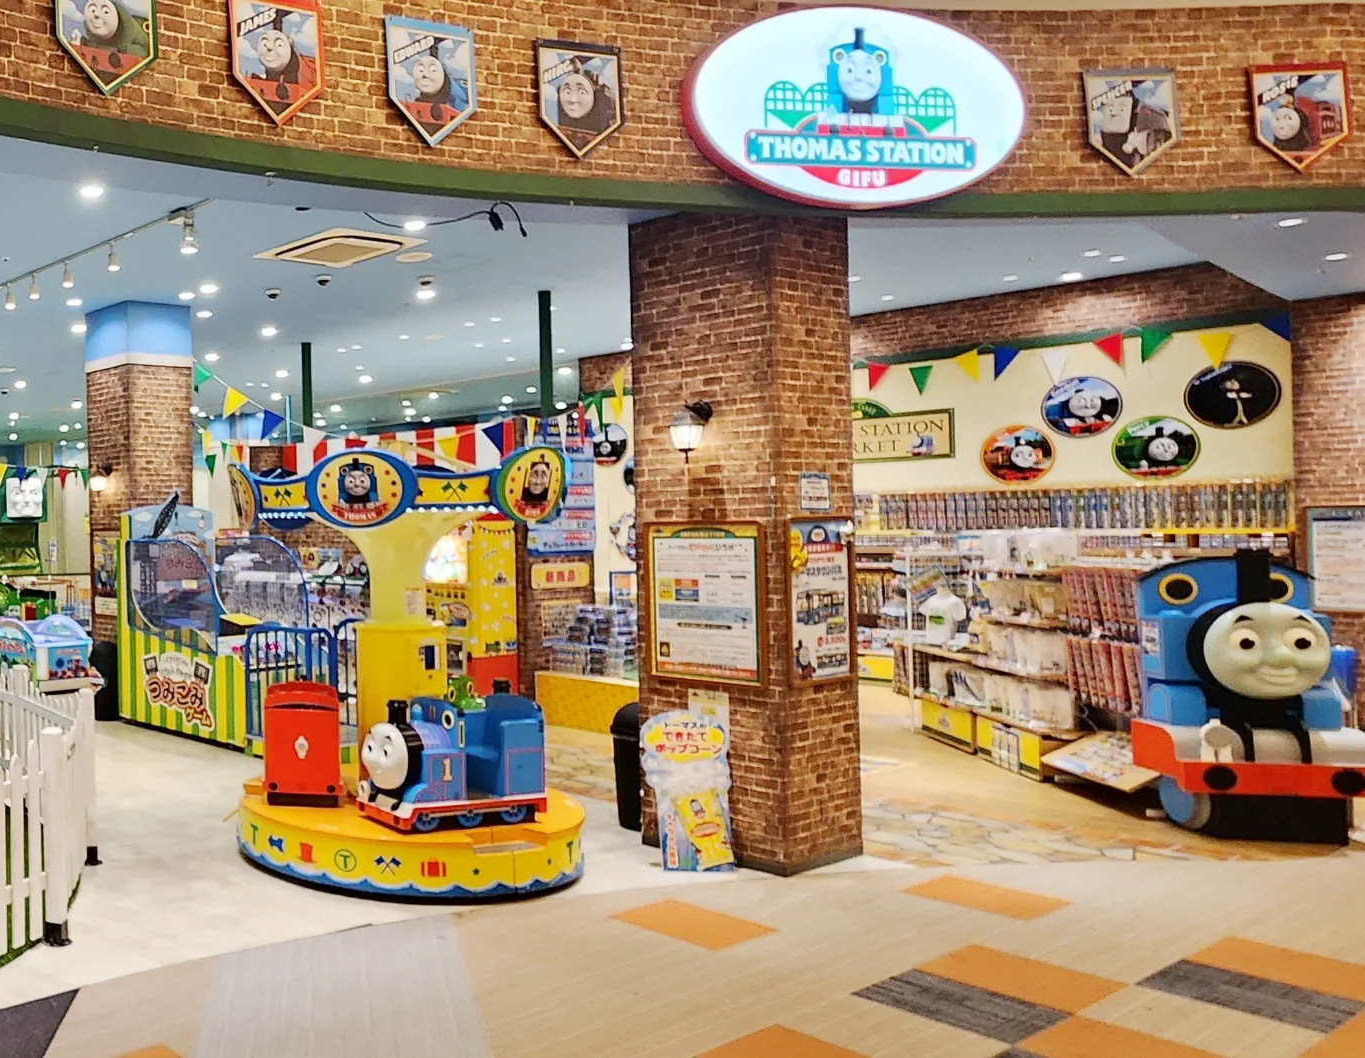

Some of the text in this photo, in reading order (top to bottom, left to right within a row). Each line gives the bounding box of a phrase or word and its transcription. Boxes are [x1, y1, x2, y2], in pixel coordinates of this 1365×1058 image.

[239, 8, 277, 36] JAMES
[394, 35, 435, 64] EDWARD
[1091, 80, 1133, 111] SPENCER
[1262, 75, 1299, 103] ROSIE
[757, 136, 966, 166] THOMAS STATION
[837, 169, 888, 187] GIFU
[860, 419, 944, 438] STATION
[344, 511, 377, 520] THOMAS
[147, 678, 206, 711] つみこみ
[185, 706, 213, 727] ゲーム
[662, 730, 708, 742] できたて
[655, 744, 723, 754] ポップコーン
[442, 757, 454, 782] 1
